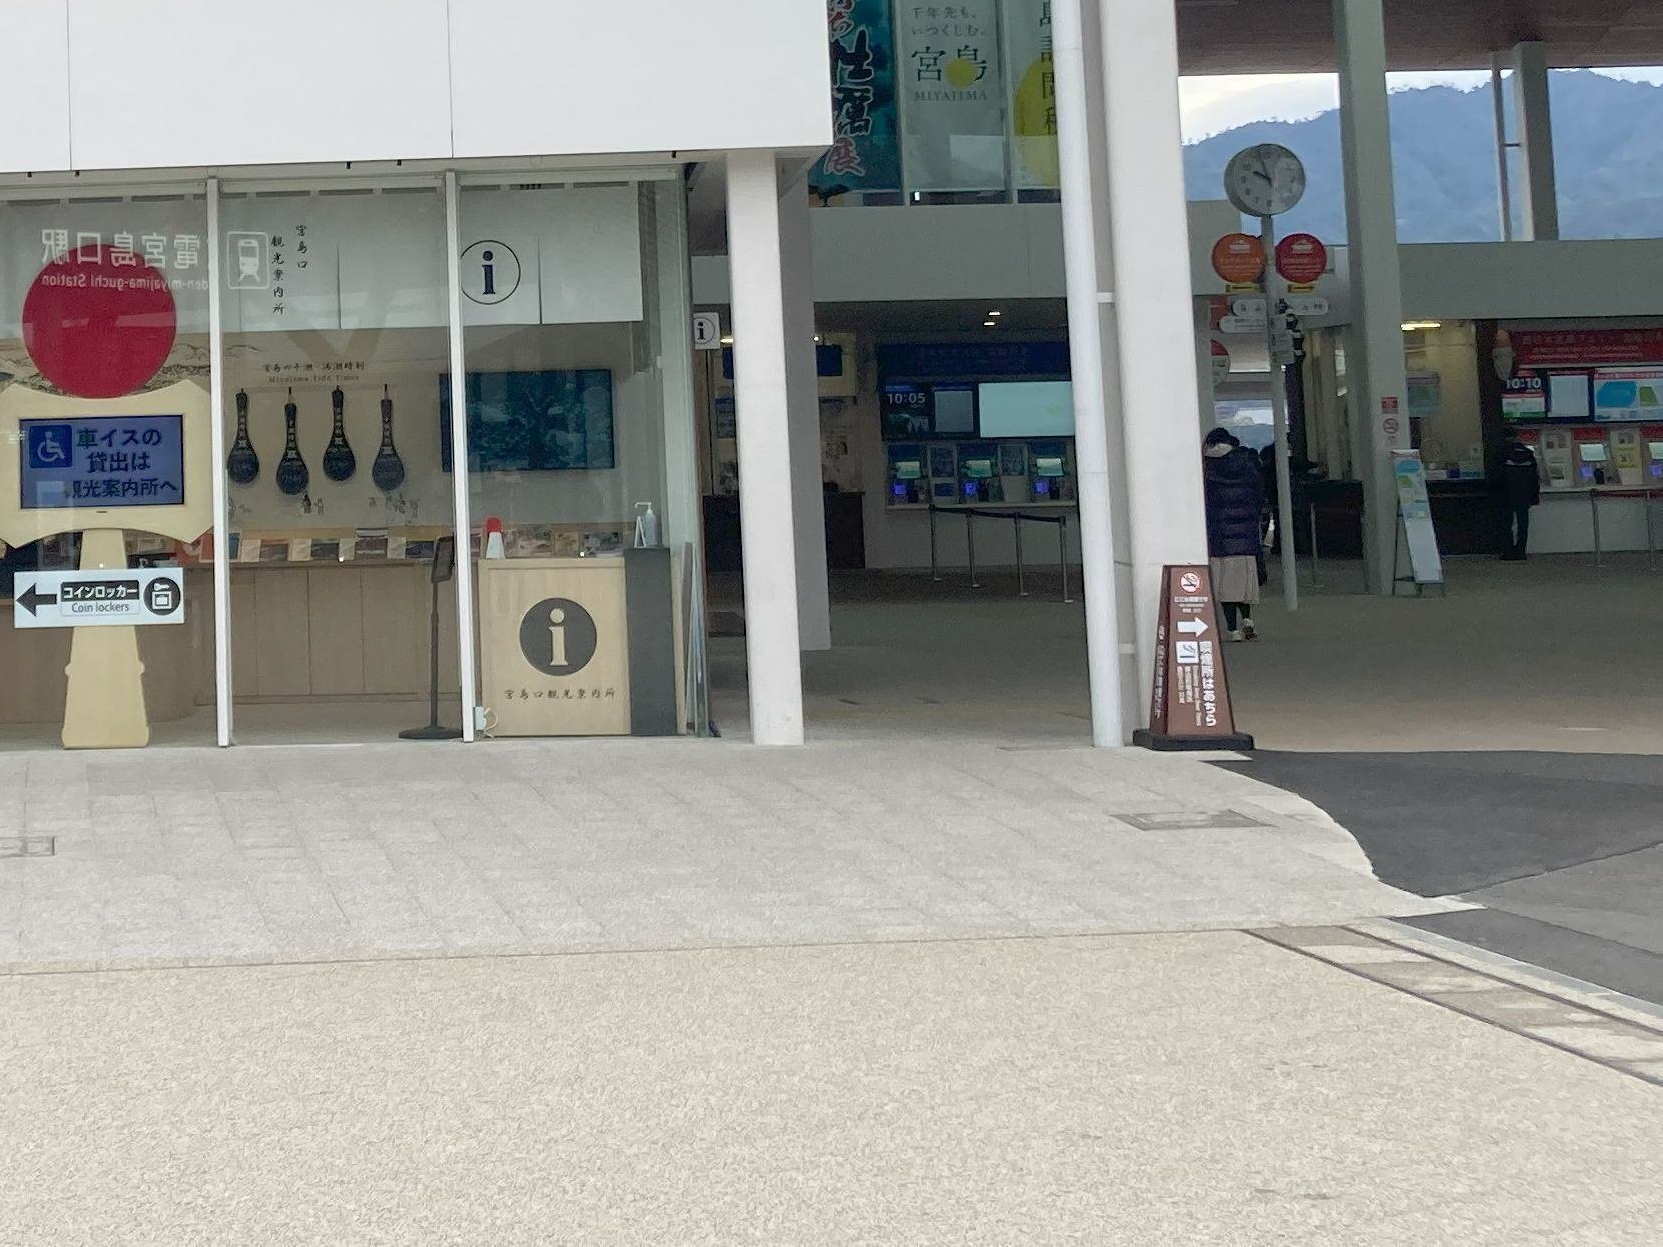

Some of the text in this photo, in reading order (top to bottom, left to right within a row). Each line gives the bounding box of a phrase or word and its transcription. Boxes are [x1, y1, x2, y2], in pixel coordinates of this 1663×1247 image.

[887, 392, 927, 405] 10:05
[76, 428, 163, 449] 車イスの
[87, 451, 151, 473] 貸出は
[63, 584, 138, 600] コインロッカー
[72, 602, 130, 614] Coin lockers
